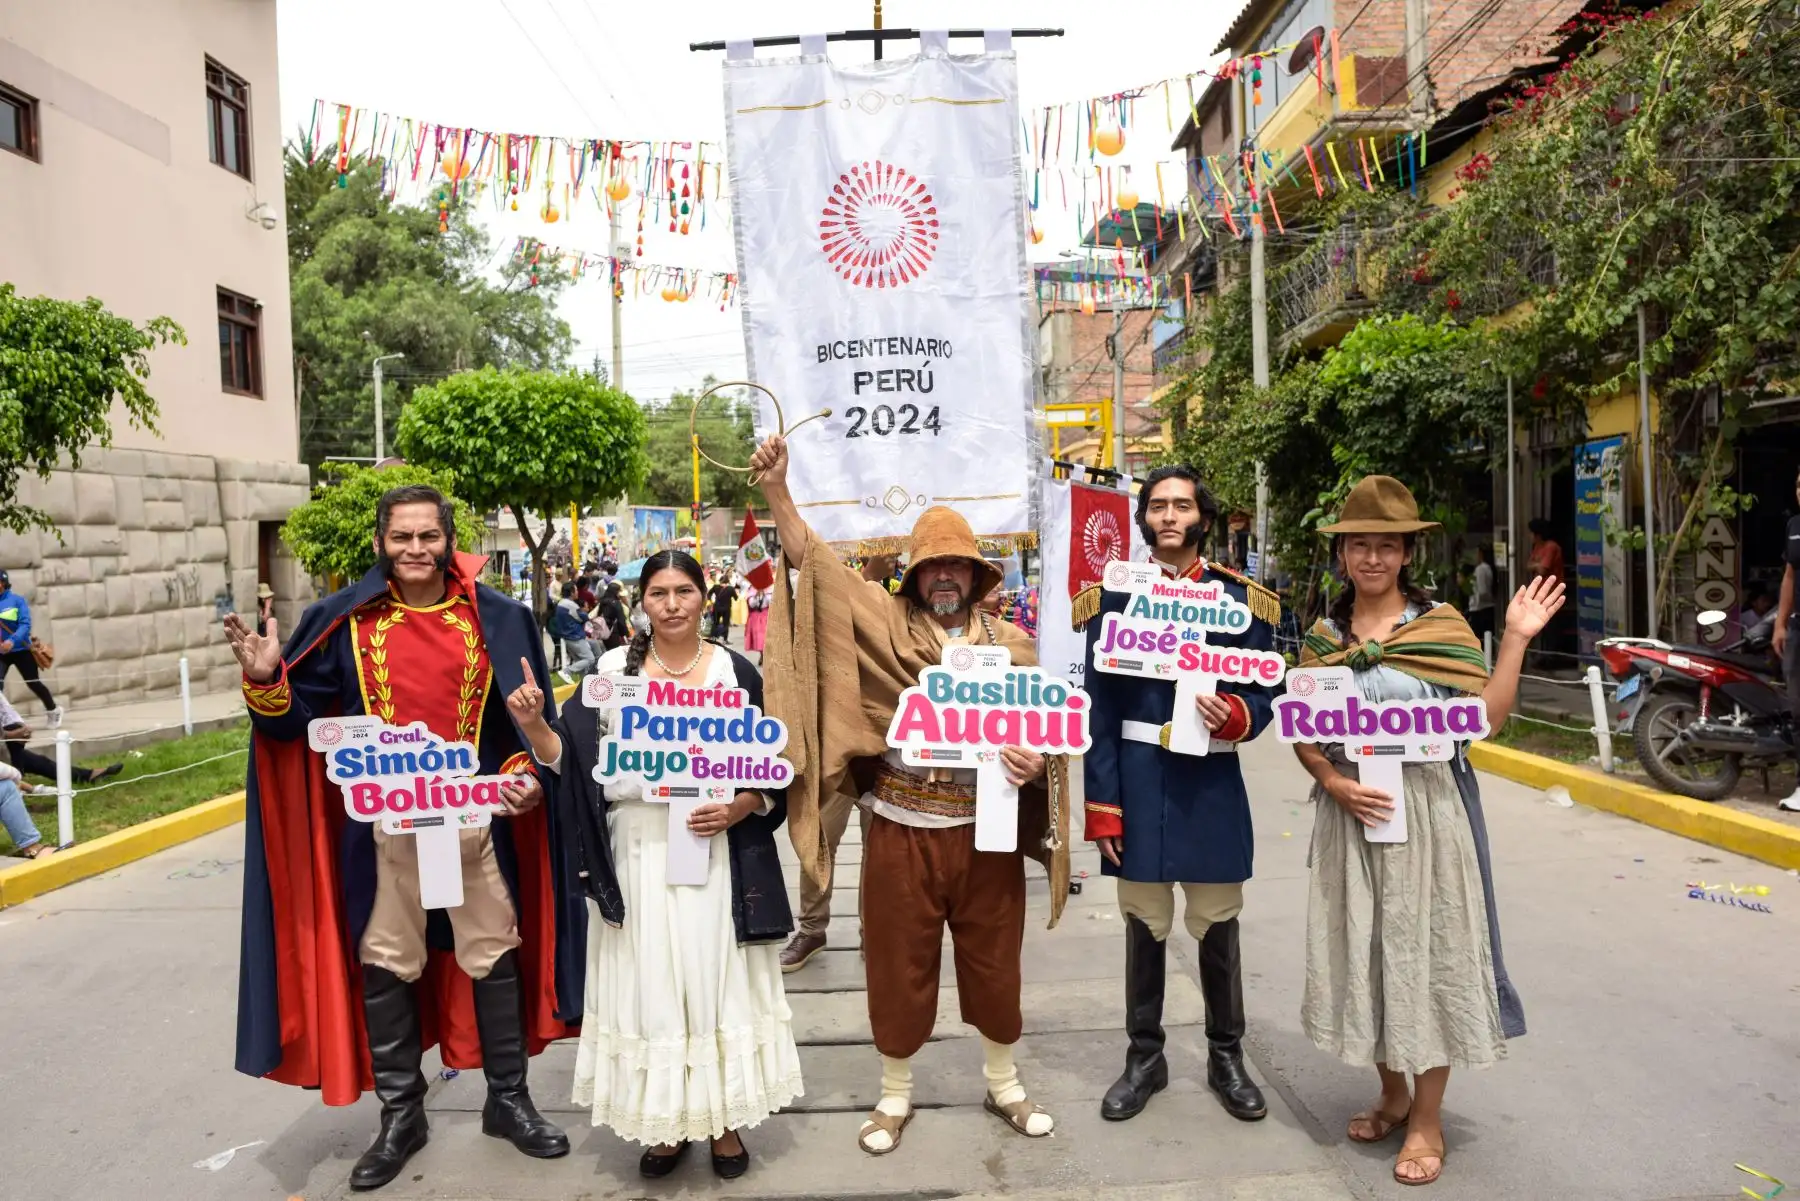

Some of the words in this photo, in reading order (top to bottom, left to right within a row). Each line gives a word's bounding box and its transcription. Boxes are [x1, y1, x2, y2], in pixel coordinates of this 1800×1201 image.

[817, 336, 953, 363] BICENTENARIO
[853, 360, 934, 395] PERÚ
[845, 403, 942, 438] 2024
[1152, 583, 1218, 600] Mariscal
[1130, 595, 1246, 628] Antonio
[1100, 619, 1178, 654] José
[1181, 627, 1200, 641] de
[1177, 642, 1279, 680] Sucre
[646, 680, 742, 708] María
[926, 672, 1067, 707] Basilio
[620, 705, 781, 744] Parado
[894, 693, 1085, 748] Auqui
[1278, 696, 1483, 737] Rabona
[379, 728, 427, 745] Gral.
[688, 744, 704, 755] de
[334, 740, 472, 778] Simón
[600, 742, 688, 782] Jayo
[691, 755, 788, 781] Bellido
